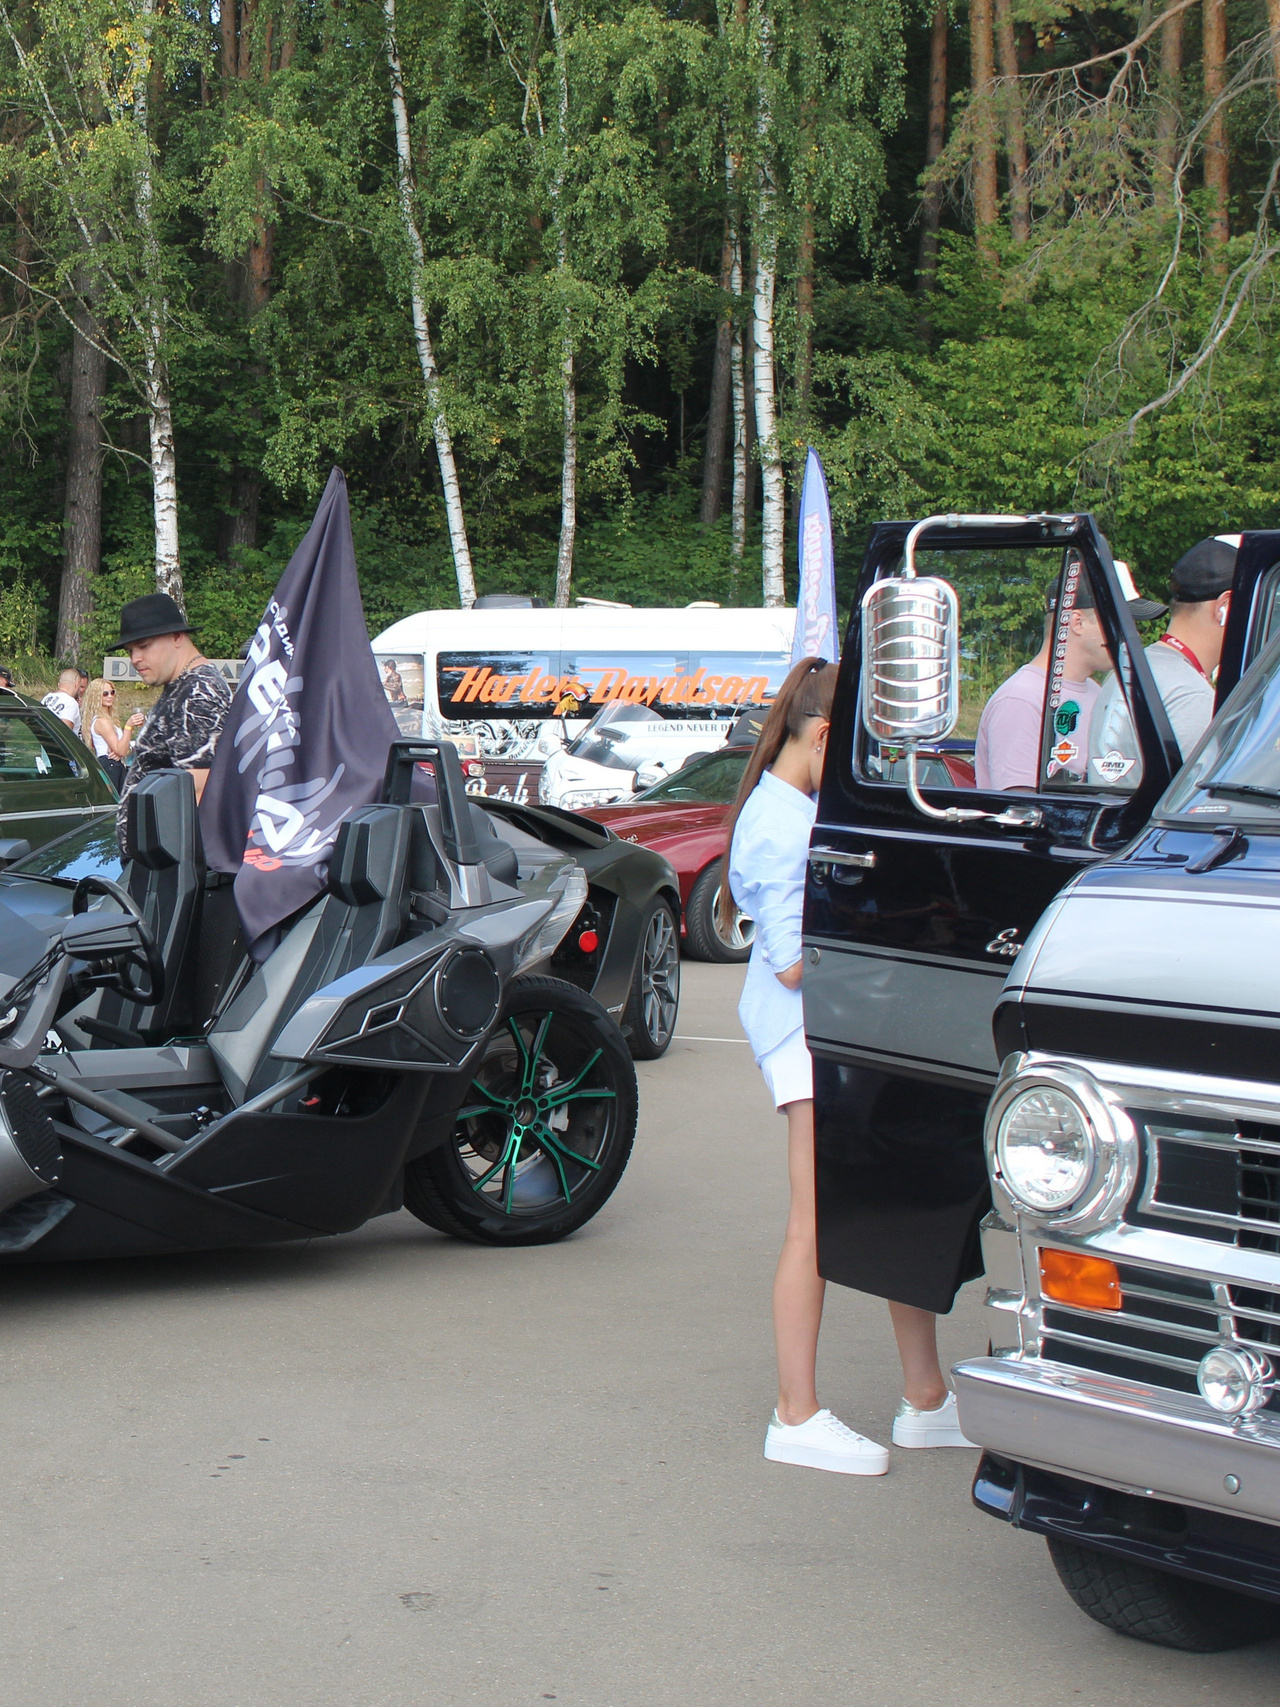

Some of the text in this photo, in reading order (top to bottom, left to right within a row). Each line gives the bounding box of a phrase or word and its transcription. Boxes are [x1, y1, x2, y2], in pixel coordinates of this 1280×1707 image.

[442, 666, 777, 716] Harley-Davidson
[647, 723, 684, 733] LEGEND
[686, 723, 718, 733] NEVER
